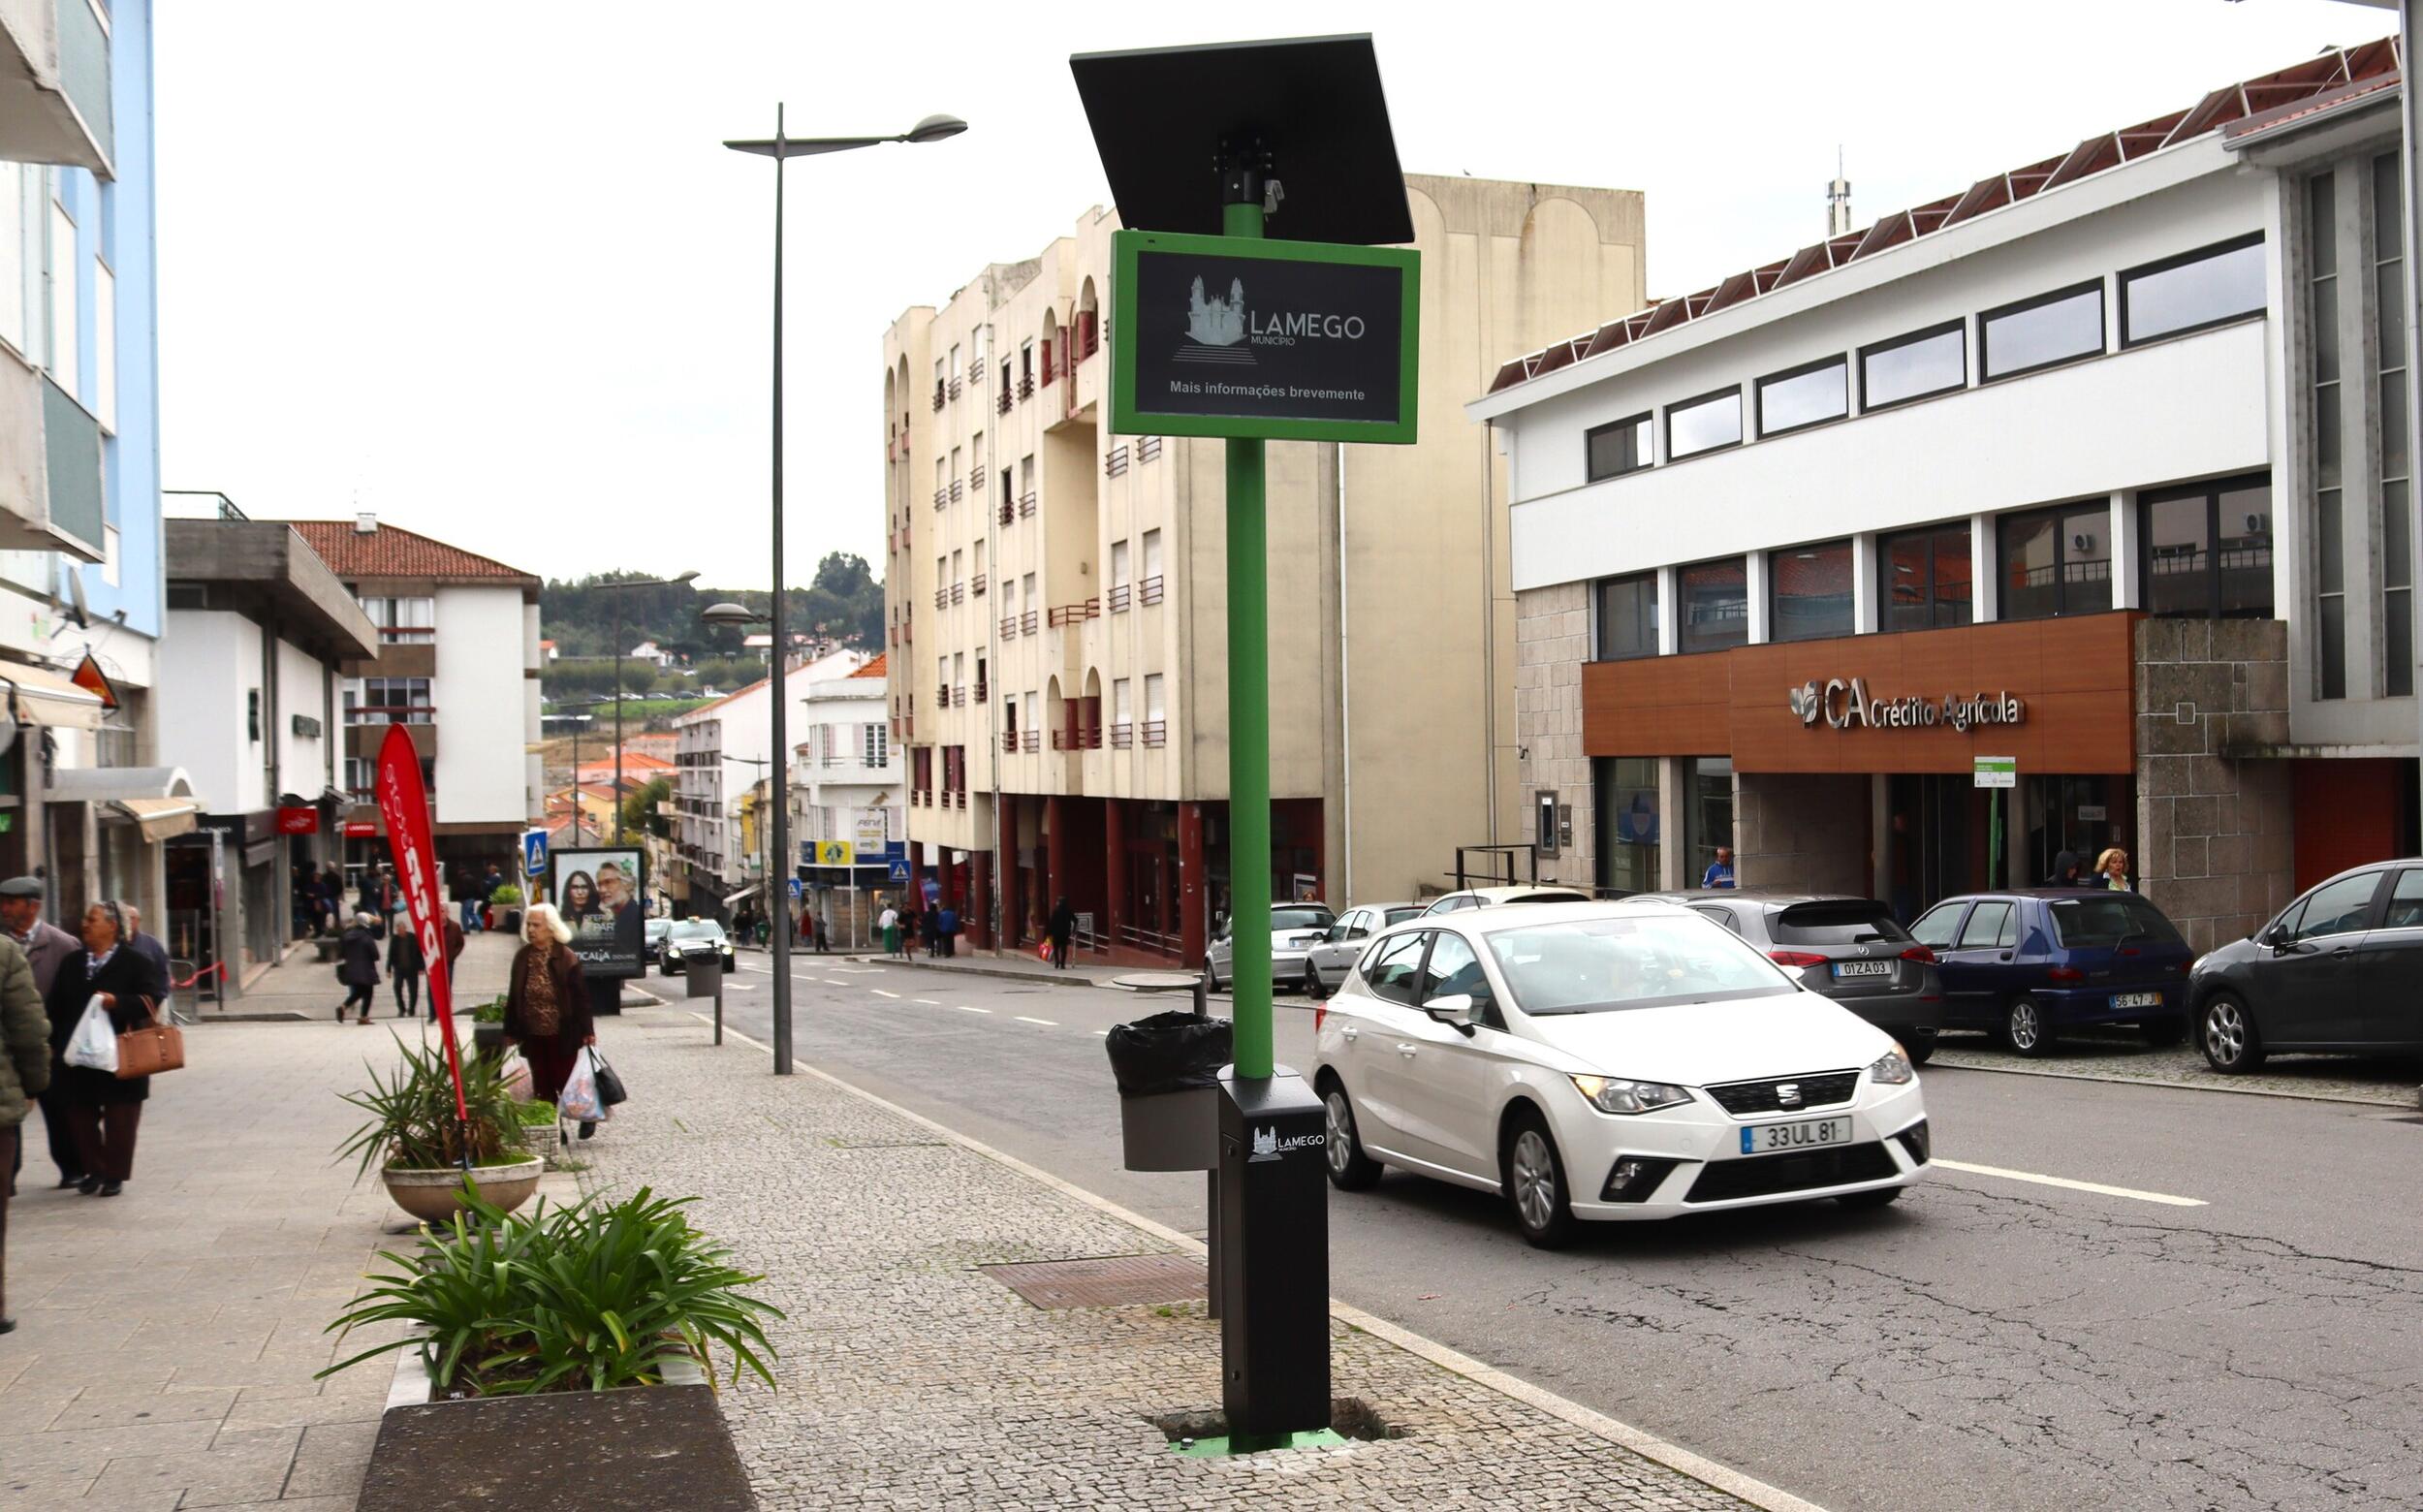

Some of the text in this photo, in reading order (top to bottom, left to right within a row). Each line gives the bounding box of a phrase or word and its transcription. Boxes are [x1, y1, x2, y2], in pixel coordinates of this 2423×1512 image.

[1251, 310, 1365, 339] LAMEGO
[1251, 335, 1295, 346] MUNICÍPIO
[1170, 381, 1365, 400] Mais informações brevemente
[1871, 696, 1936, 727] Crédito
[1940, 690, 2023, 733] Agrícola
[1278, 1135, 1325, 1148] LAMEGO
